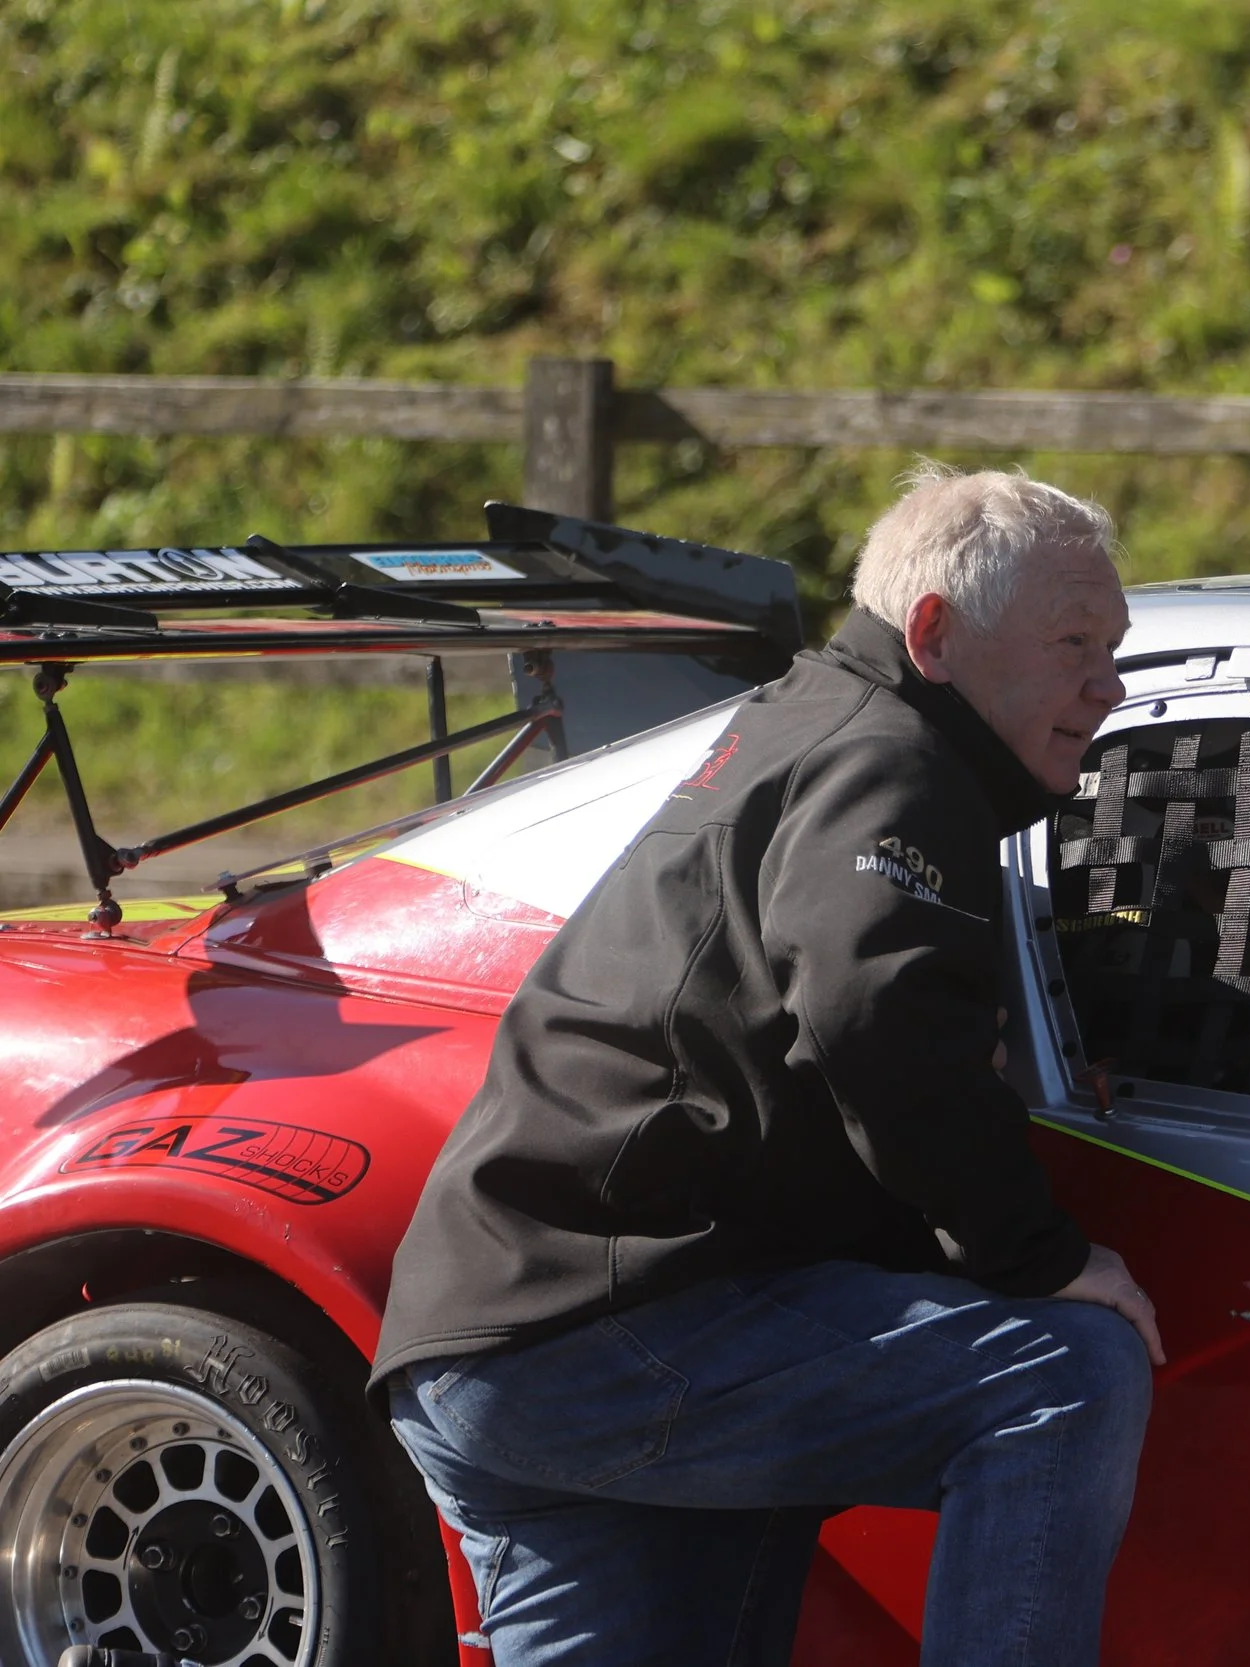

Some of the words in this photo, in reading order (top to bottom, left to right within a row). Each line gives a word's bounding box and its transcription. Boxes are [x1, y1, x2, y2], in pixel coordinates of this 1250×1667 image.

[855, 854, 913, 887] DANNY
[879, 835, 944, 893] 490
[74, 1124, 268, 1167] GAZ
[239, 1144, 349, 1187] SHOCKS
